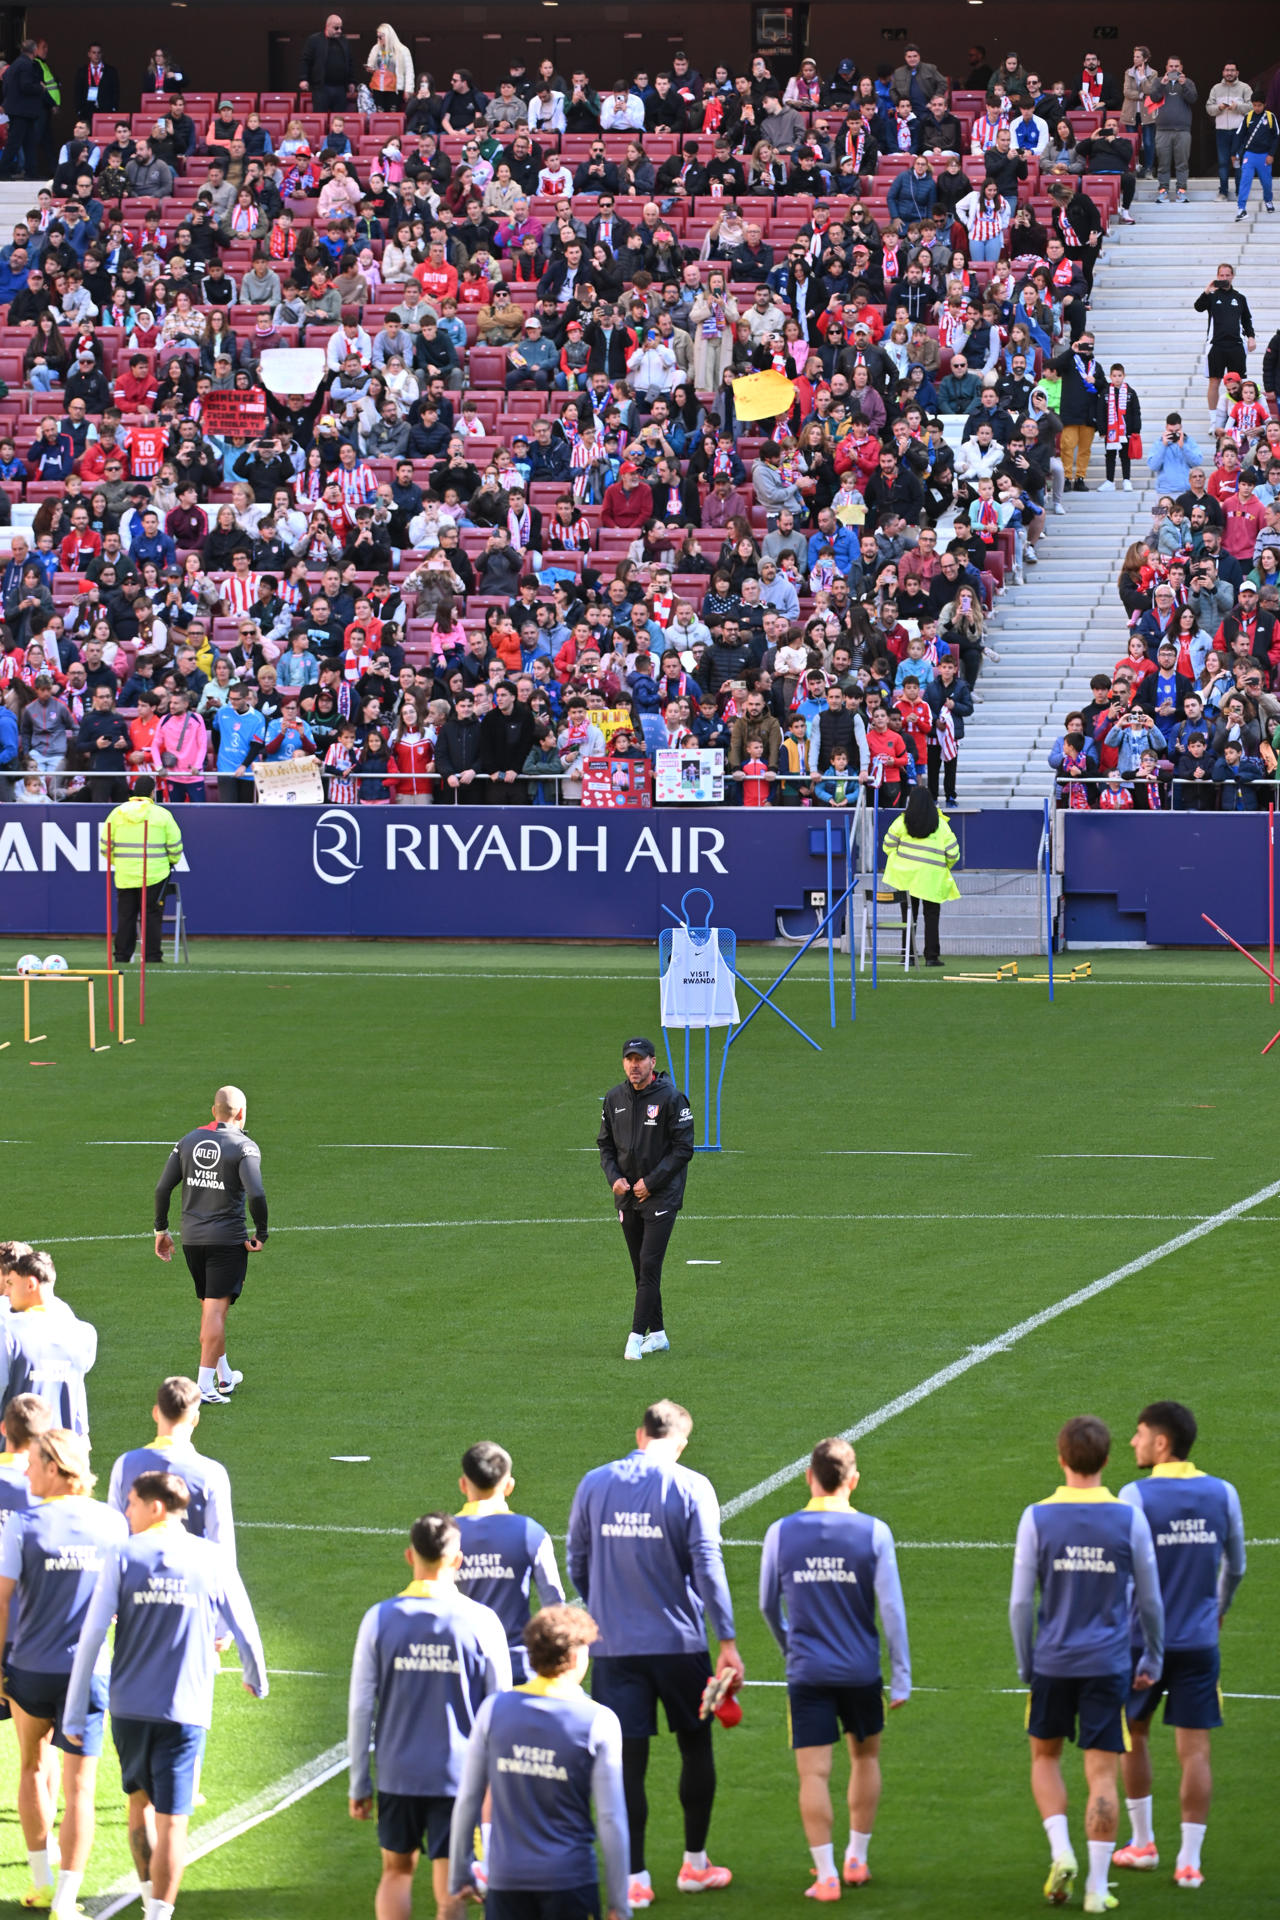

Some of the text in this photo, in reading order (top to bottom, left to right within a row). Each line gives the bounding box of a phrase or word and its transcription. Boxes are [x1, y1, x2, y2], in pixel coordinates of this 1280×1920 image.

[138, 440, 155, 456] 10
[386, 824, 728, 874] RIYADH AIR
[195, 1147, 217, 1159] ATLETI
[194, 1169, 218, 1180] VISIT
[186, 1177, 225, 1190] RWANDA
[614, 1511, 651, 1525] VISIT
[1169, 1518, 1206, 1532] VISIT
[601, 1523, 664, 1539] RWANDA
[1157, 1531, 1217, 1546] RWANDA
[463, 1553, 502, 1567] VISIT
[1065, 1546, 1104, 1560] VISIT
[805, 1557, 845, 1569] VISIT
[1053, 1558, 1116, 1573] RWANDA
[793, 1569, 857, 1584] RWANDA
[409, 1643, 450, 1658] VISIT
[512, 1744, 556, 1764] VISIT
[497, 1756, 569, 1782] RWANDA
